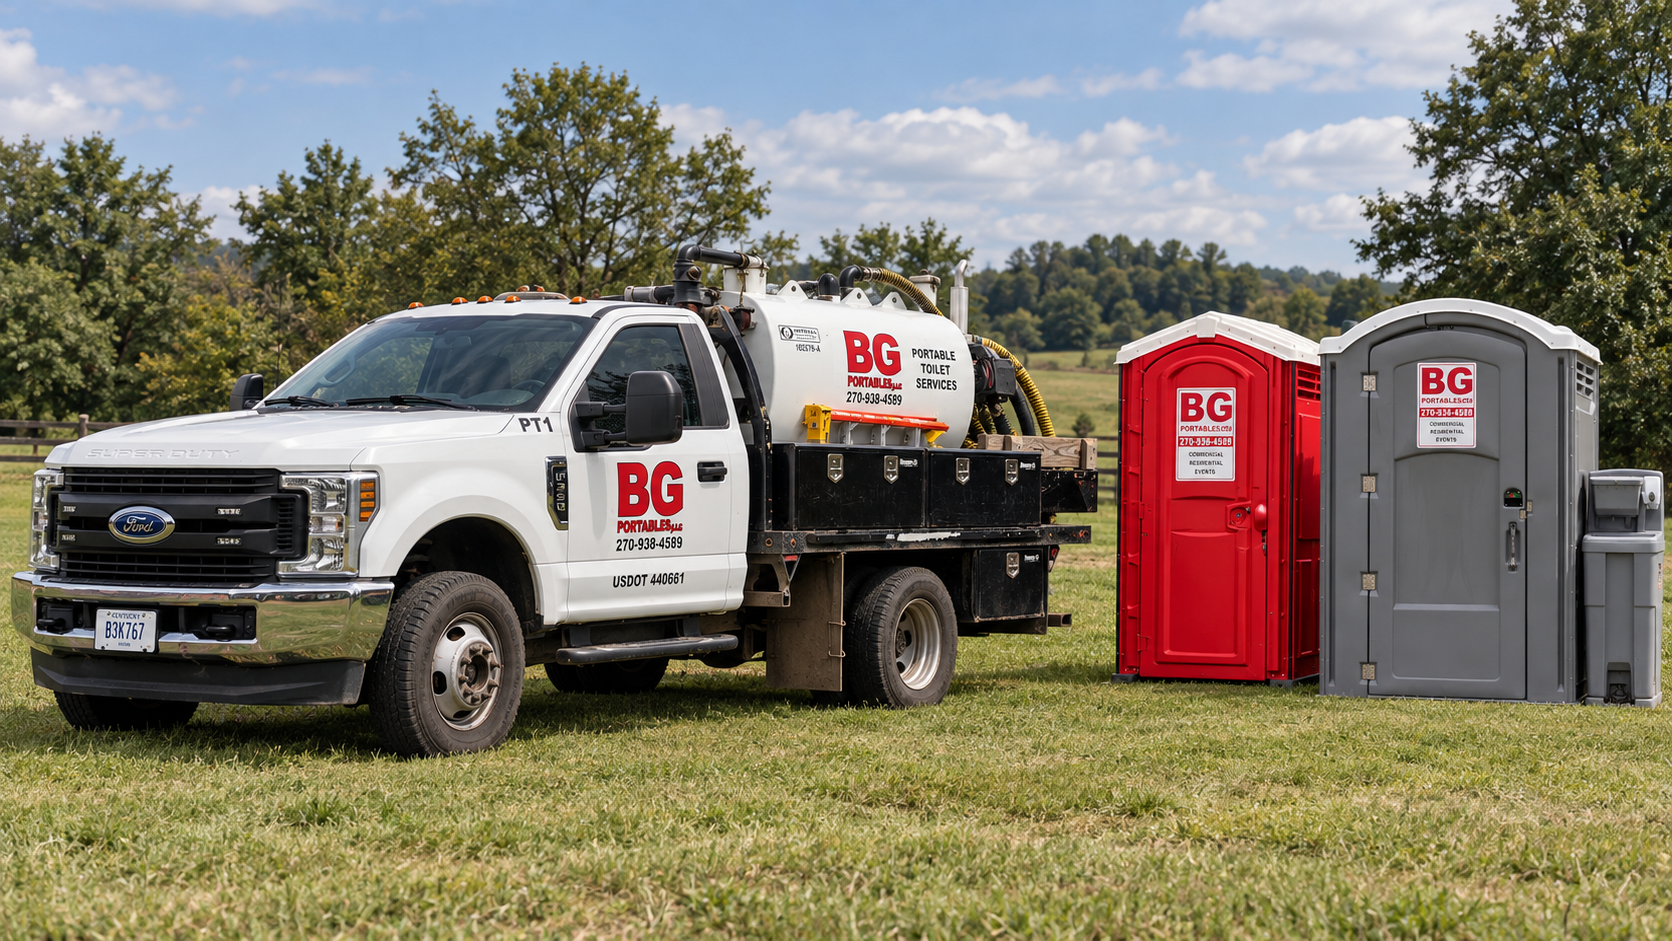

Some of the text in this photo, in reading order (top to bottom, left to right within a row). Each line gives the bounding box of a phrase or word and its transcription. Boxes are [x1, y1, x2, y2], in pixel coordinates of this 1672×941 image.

[843, 330, 902, 376] BG
[912, 349, 956, 361] PORTABLE
[921, 363, 950, 375] TOILET
[916, 378, 957, 391] SERVICES
[1422, 367, 1473, 395] BG
[1180, 392, 1233, 422] BG
[518, 417, 553, 432] PT1
[85, 449, 240, 458] SUPER DUTY
[617, 461, 683, 517] BG
[123, 515, 153, 533] Ford
[616, 536, 683, 552] 270-938-4589
[613, 572, 684, 588] USDOT 440661
[105, 621, 145, 640] B3K767
